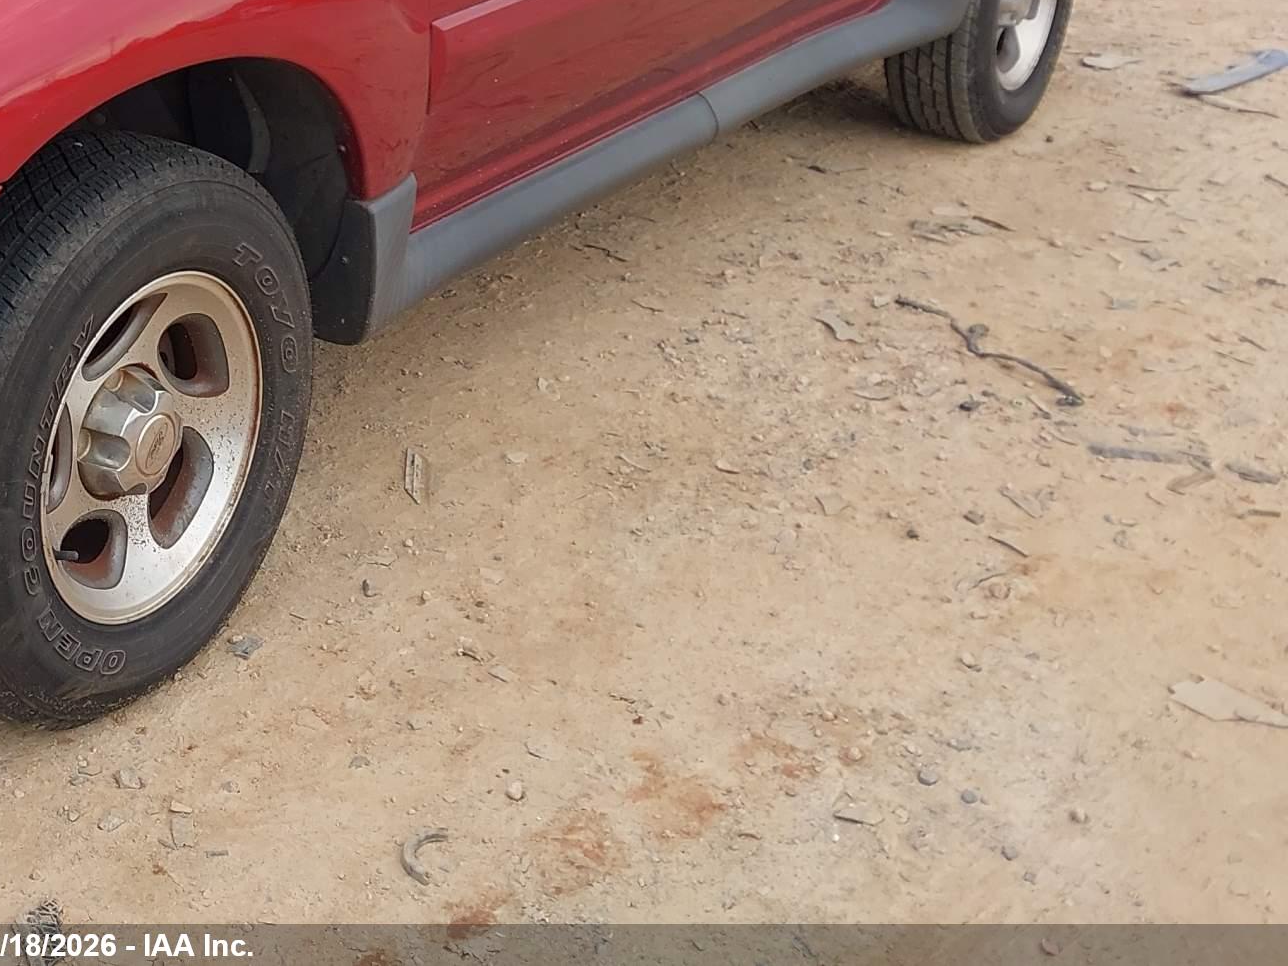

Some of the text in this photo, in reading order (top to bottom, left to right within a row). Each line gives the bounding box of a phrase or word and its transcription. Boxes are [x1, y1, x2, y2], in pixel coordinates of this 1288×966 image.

[232, 242, 299, 374] TOYO
[20, 313, 127, 675] OPEN COUNTRY
